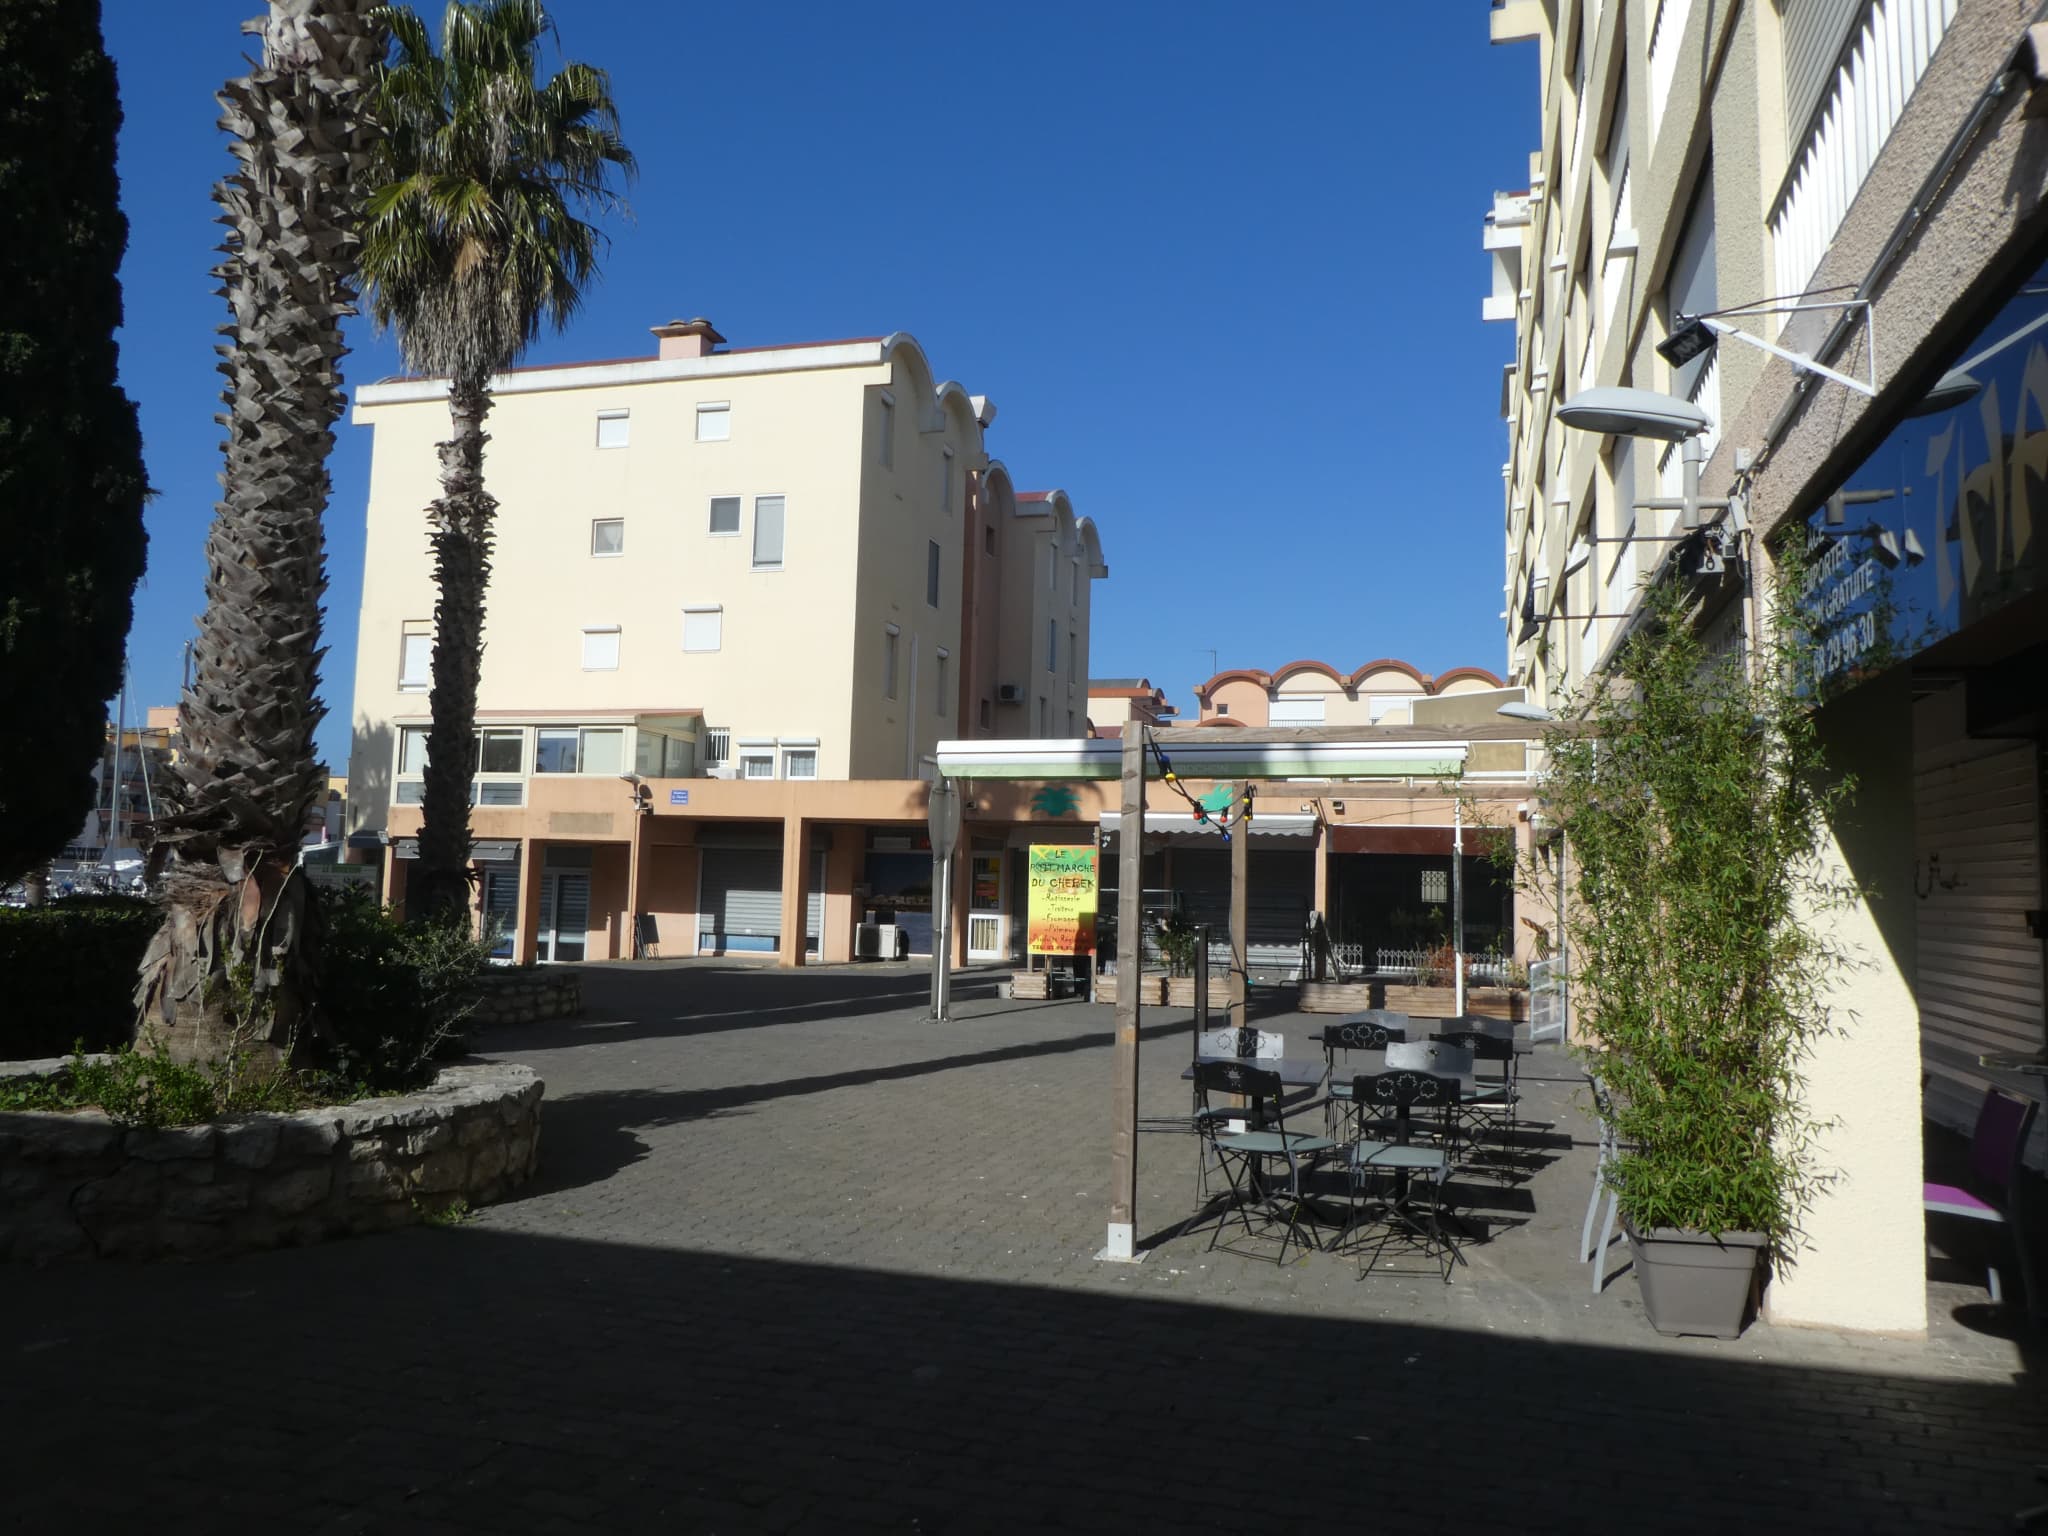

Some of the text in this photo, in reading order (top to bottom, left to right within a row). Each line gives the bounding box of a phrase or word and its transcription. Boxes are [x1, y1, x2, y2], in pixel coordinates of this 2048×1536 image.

[1801, 535, 1849, 599] EMPORTER
[1825, 558, 1874, 618] GRATUITE
[1827, 632, 1840, 667] 29
[1842, 621, 1856, 662] 96
[1858, 610, 1874, 652] 30
[1055, 850, 1066, 858] LE
[1031, 879, 1044, 887] DU
